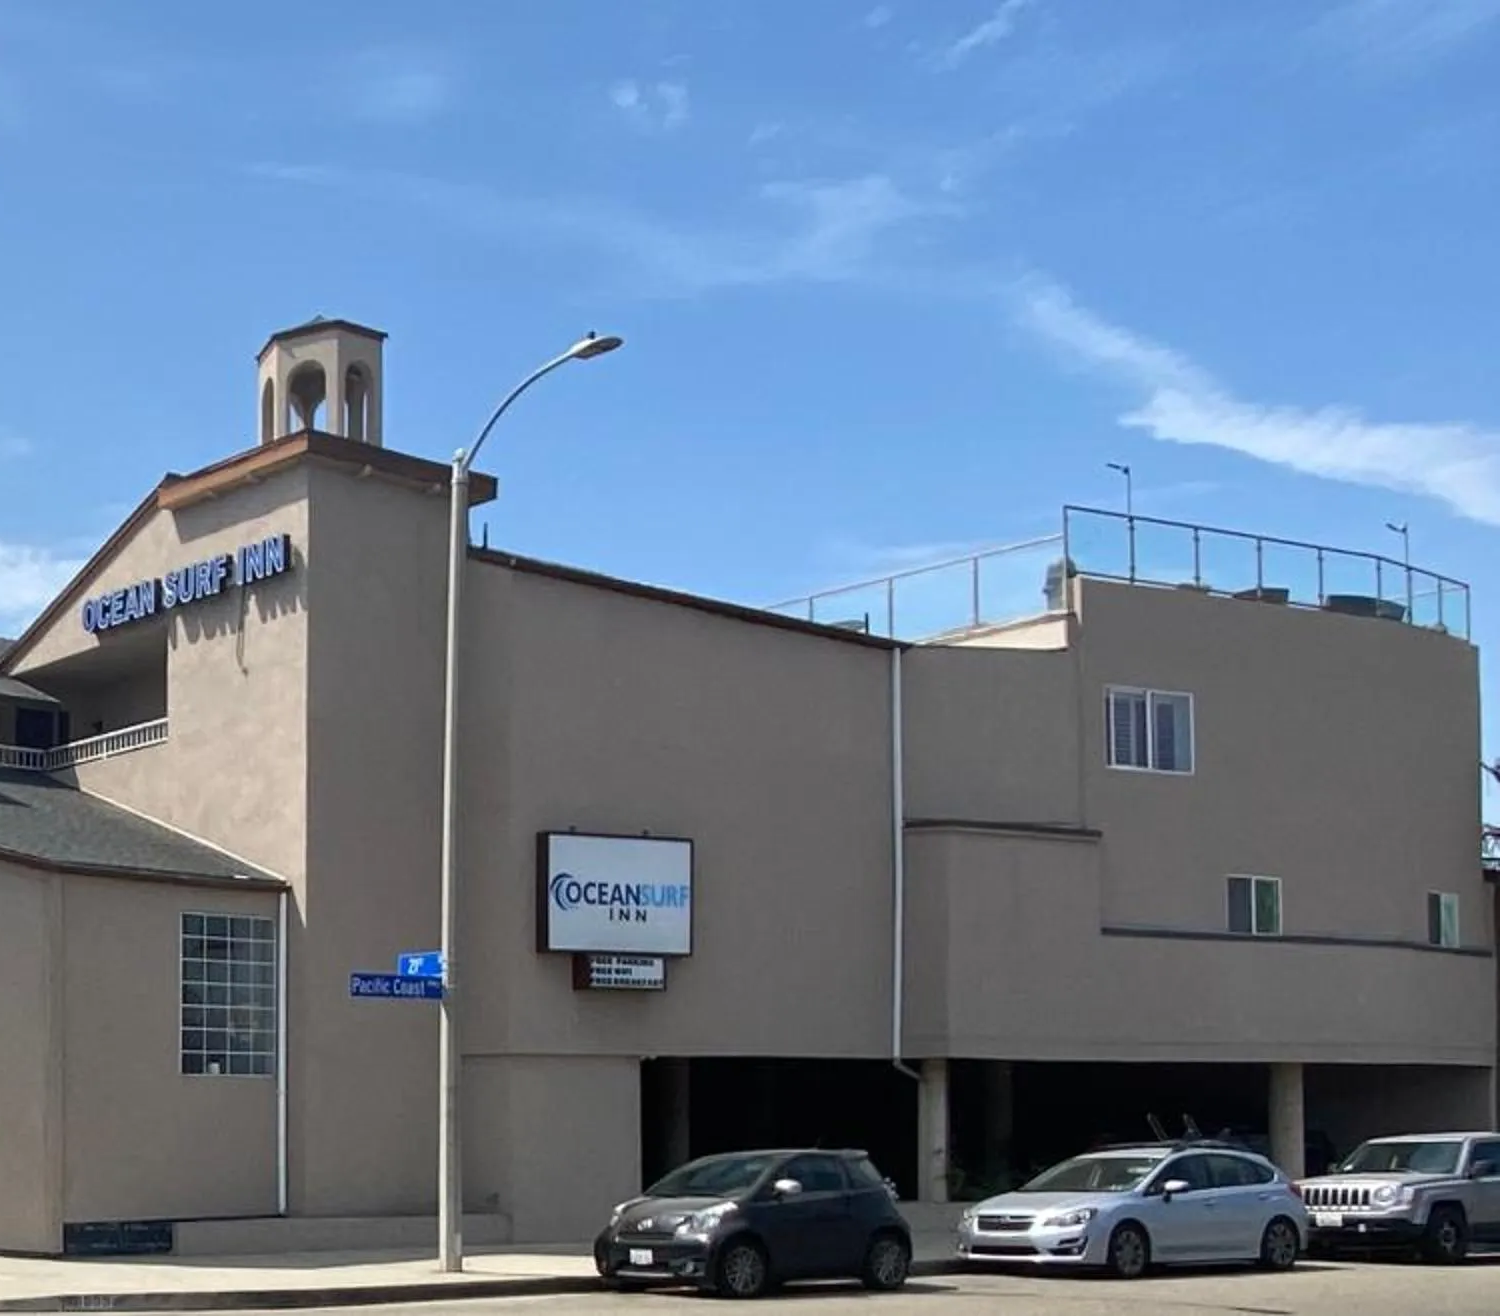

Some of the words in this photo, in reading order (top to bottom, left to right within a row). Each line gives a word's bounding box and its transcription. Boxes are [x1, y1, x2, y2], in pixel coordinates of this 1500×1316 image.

[82, 578, 157, 633] OCEAN
[162, 555, 228, 608] SURF
[235, 533, 286, 586] INN
[565, 881, 689, 908] OCEANSURF
[608, 907, 648, 922] INN
[352, 977, 390, 993] Pacific
[393, 978, 425, 995] Coast
